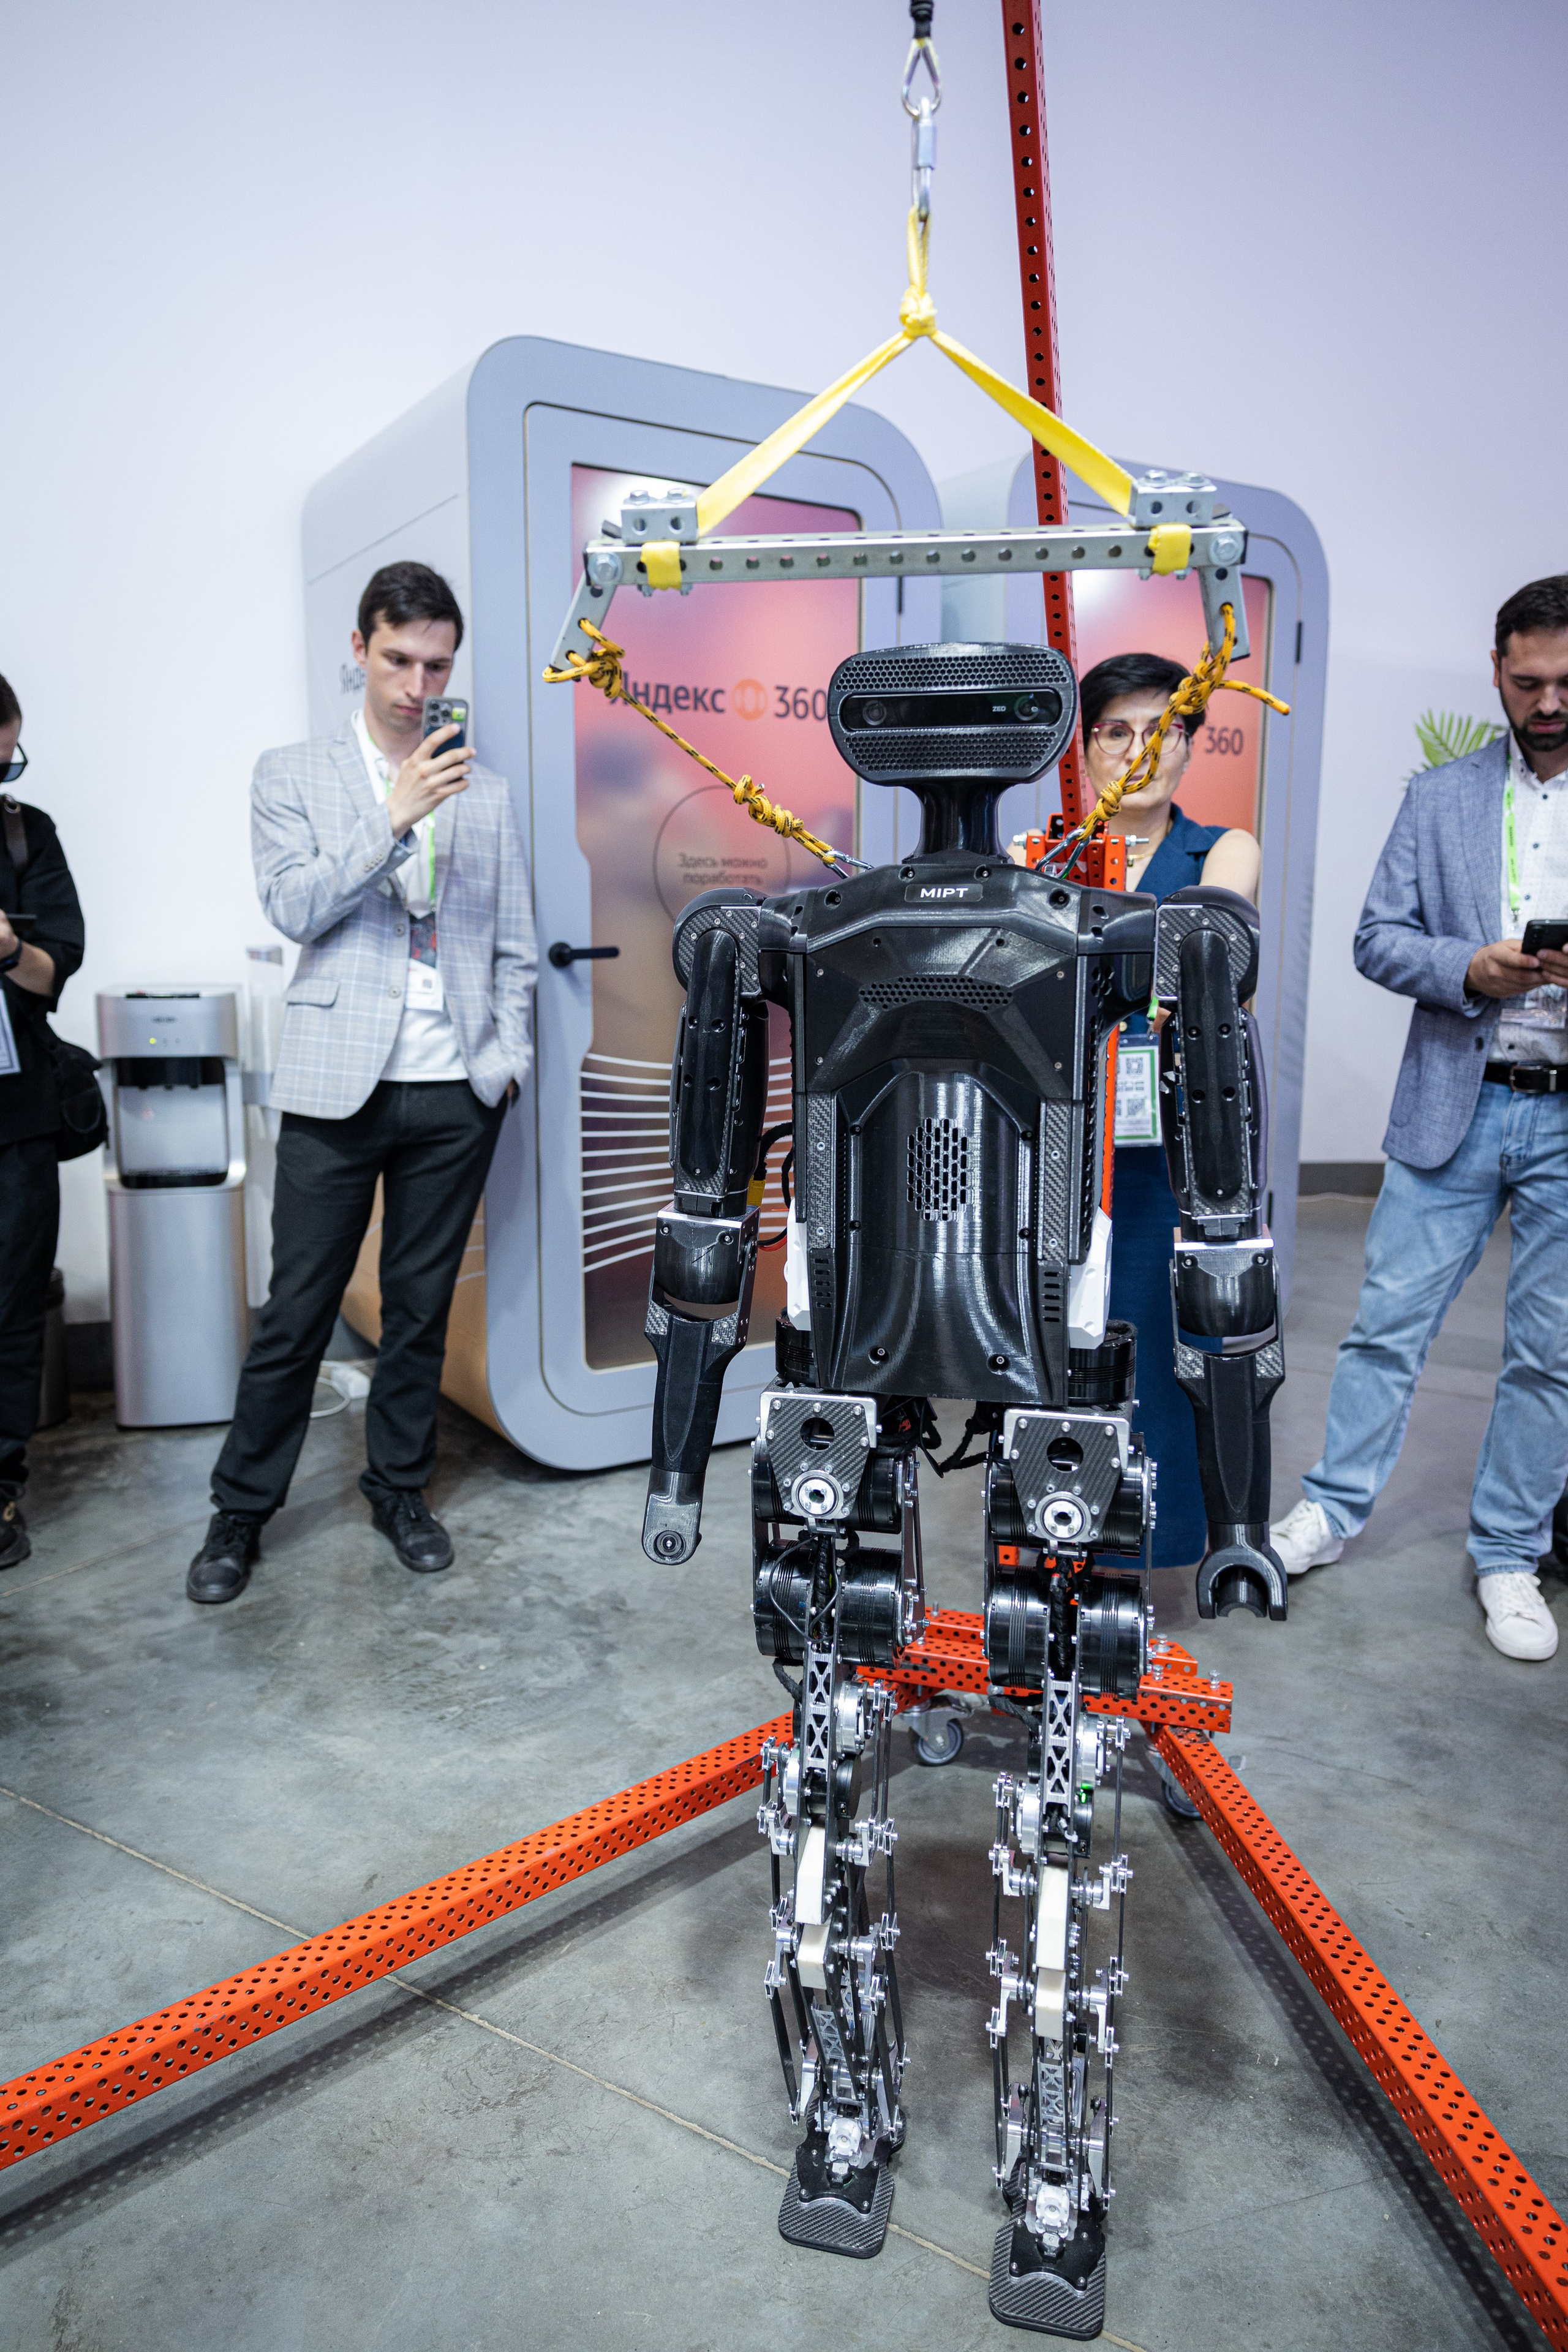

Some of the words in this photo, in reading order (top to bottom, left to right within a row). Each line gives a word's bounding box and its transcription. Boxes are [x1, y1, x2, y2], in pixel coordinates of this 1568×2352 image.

[775, 685, 827, 720] 360
[1205, 726, 1243, 755] 360
[920, 888, 969, 898] MIPT
